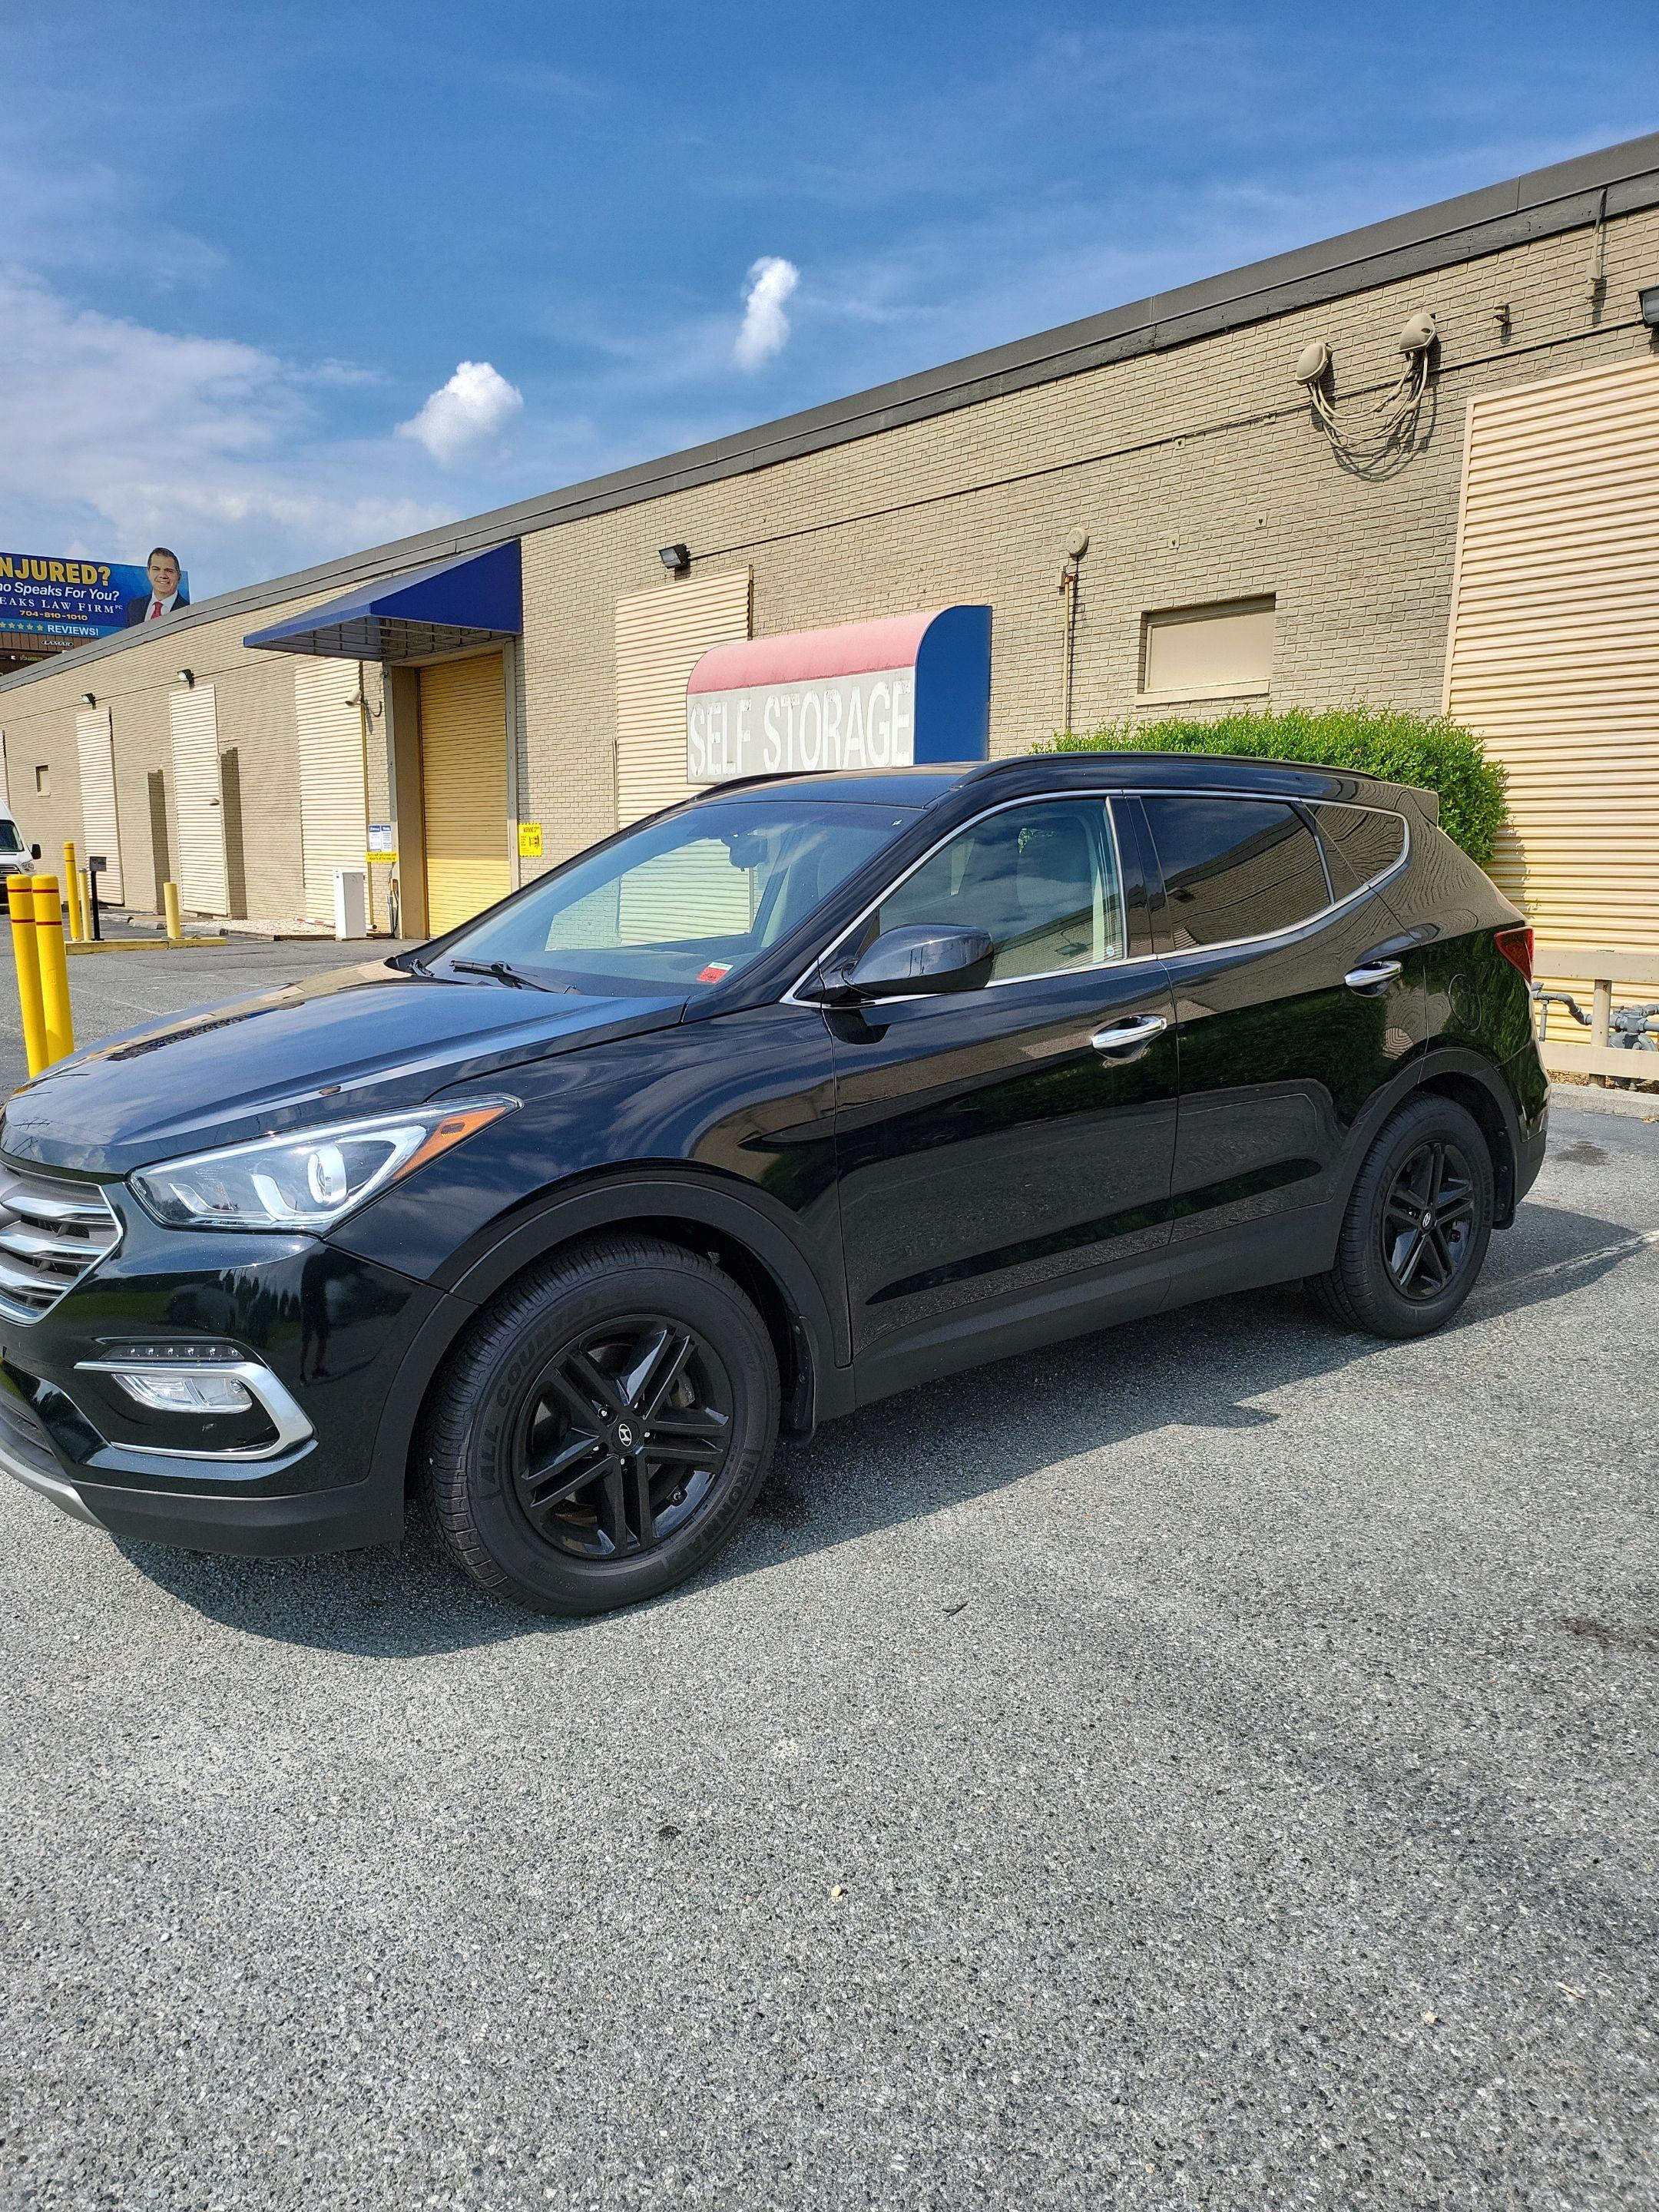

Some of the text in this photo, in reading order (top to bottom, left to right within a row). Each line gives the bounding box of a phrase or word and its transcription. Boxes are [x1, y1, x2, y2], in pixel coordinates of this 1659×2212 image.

[14, 581, 62, 597] Speaks
[65, 586, 87, 598] For
[89, 588, 120, 601] You?
[0, 596, 35, 607] EAKS
[41, 599, 71, 610] LAW
[78, 602, 114, 614] FIRM
[19, 610, 88, 621] 704-810-1010
[47, 624, 99, 636] REVIEWS!
[690, 679, 912, 777] SELF STORAGE
[479, 1424, 500, 1488] ALL
